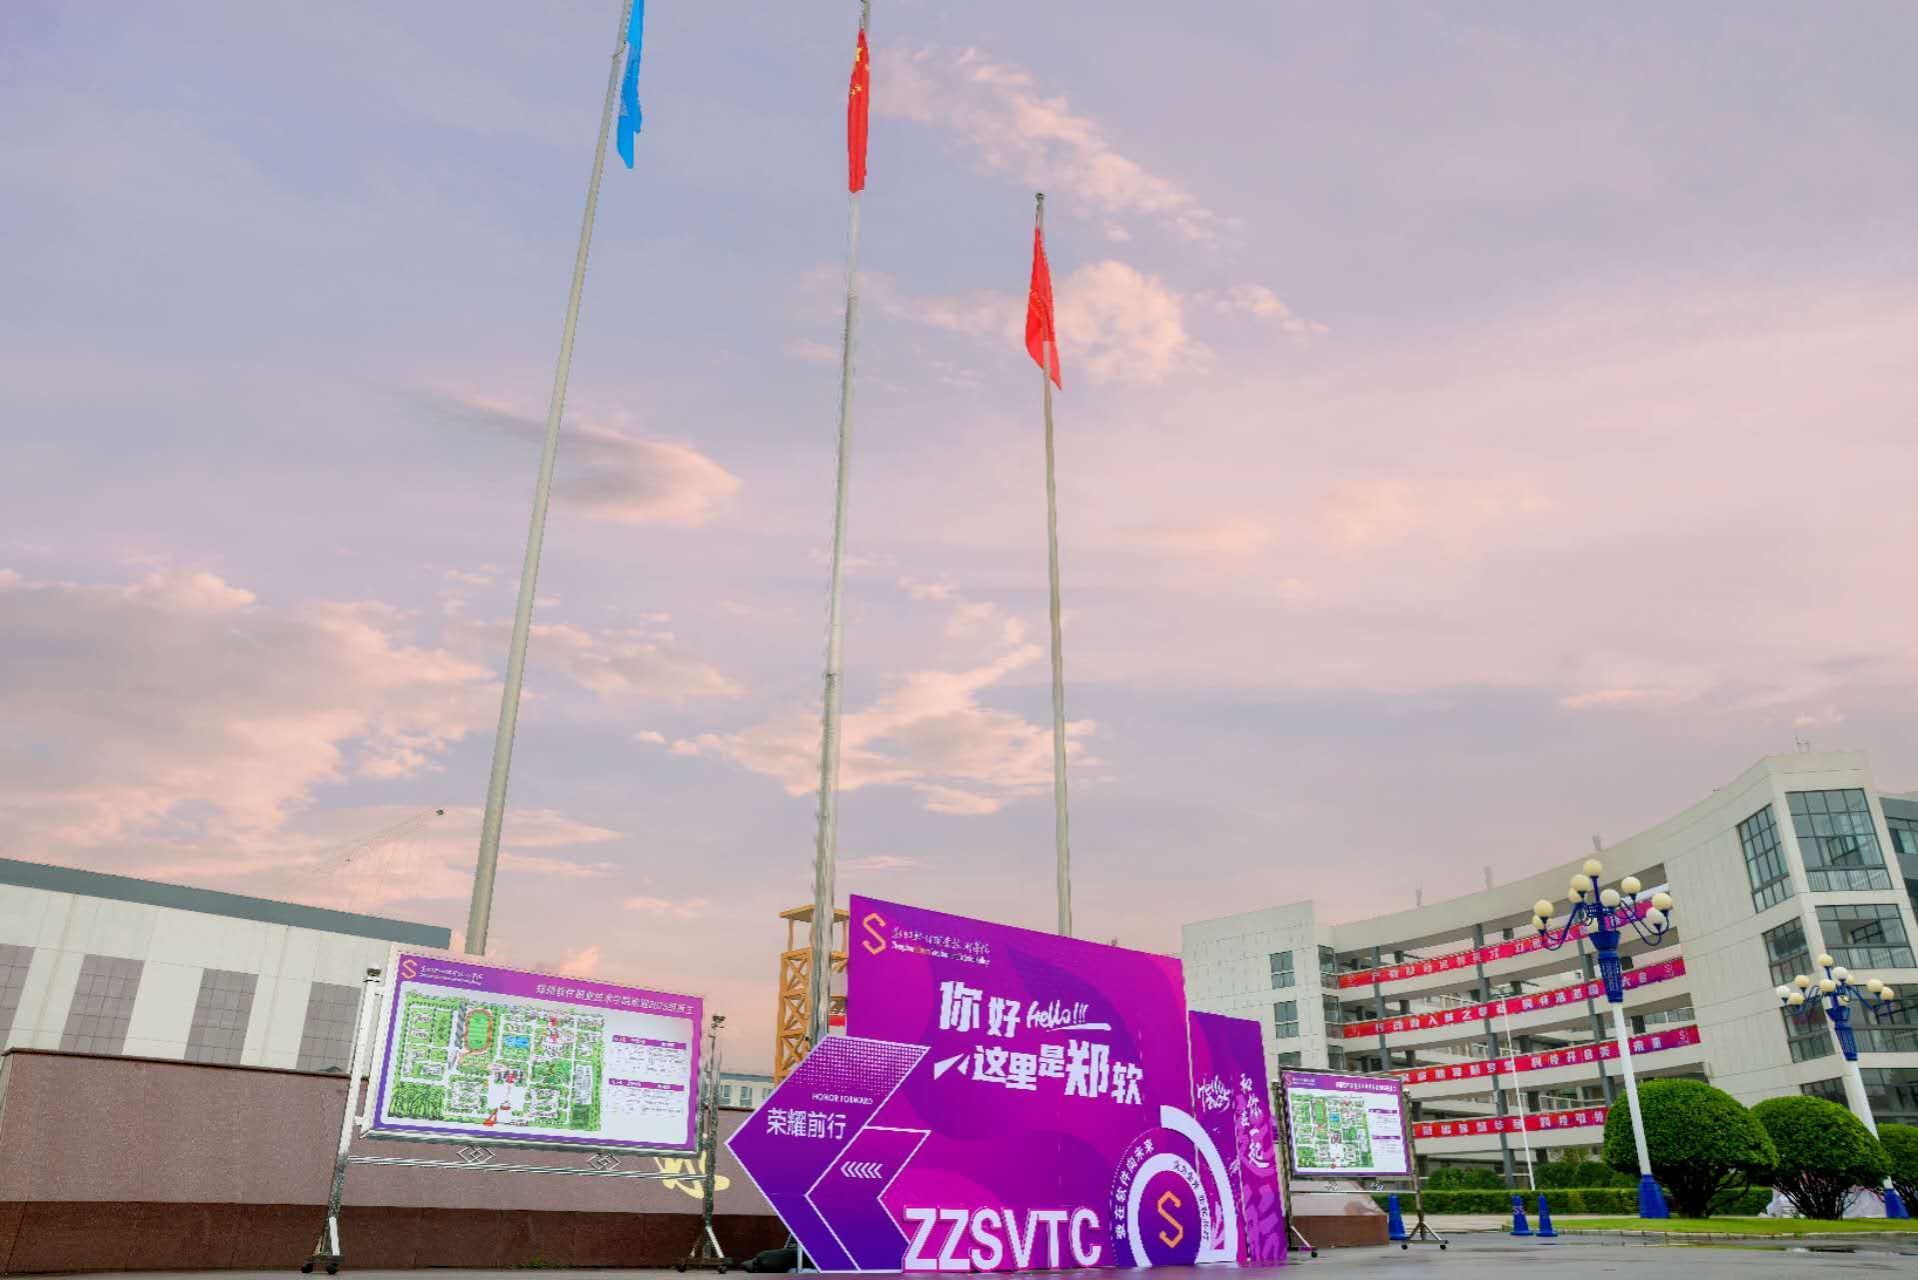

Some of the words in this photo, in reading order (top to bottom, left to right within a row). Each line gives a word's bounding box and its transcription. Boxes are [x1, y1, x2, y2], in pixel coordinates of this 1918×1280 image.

[939, 980, 1021, 1038] 你好
[812, 1093, 840, 1102] HONOR
[840, 1096, 874, 1105] FORWARD
[972, 1039, 1143, 1104] 这里是郑软
[766, 1107, 847, 1139] 荣耀前行
[904, 1206, 1102, 1270] ZZSVTC
